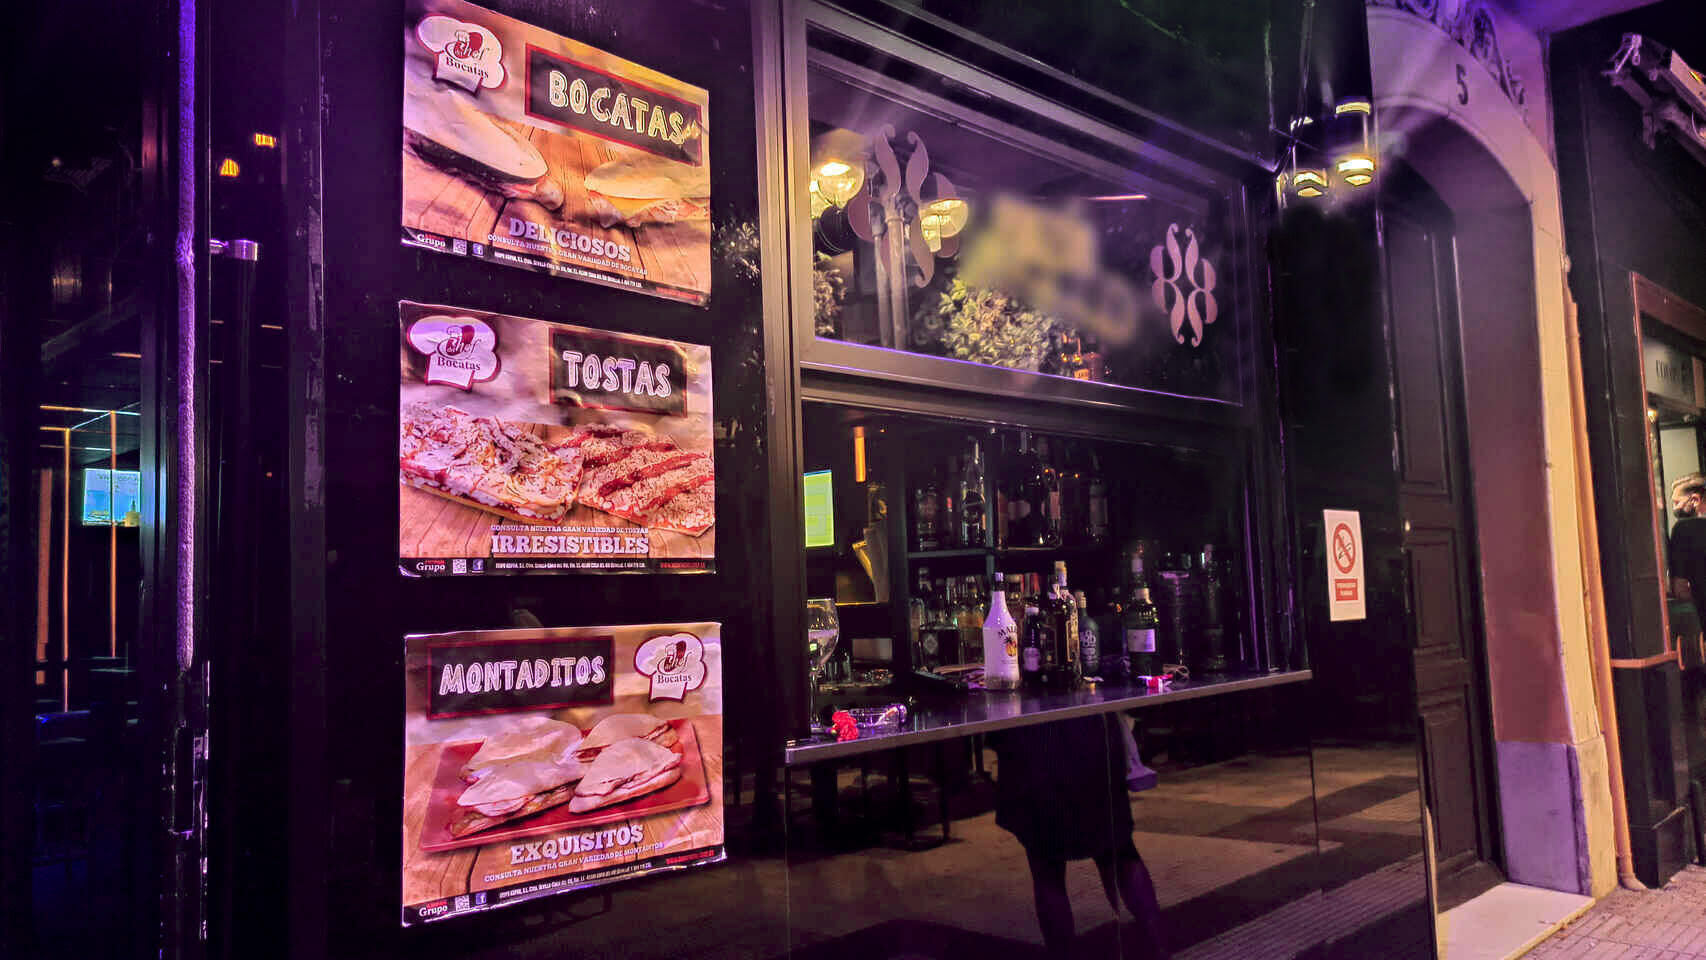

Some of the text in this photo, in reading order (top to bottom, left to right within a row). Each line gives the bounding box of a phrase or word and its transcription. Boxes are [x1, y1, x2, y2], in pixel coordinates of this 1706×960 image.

[446, 57, 488, 78] Bocatas
[1456, 64, 1468, 105] 5
[549, 70, 685, 145] BOCATAS
[417, 233, 446, 247] Grupo
[488, 234, 526, 247] CONSULTA
[510, 217, 631, 262] DELICIOSOS
[437, 356, 480, 370] Bocatas
[562, 350, 672, 398] TOSTAS
[490, 524, 529, 532] CONSULTA
[490, 535, 649, 553] IRRESISTIBLES
[416, 562, 446, 573] Grupo
[439, 656, 607, 695] MONTADITOS
[657, 675, 692, 684] Bocatas
[510, 824, 644, 865] EXQUISITOS
[484, 869, 523, 882] CONSULTA
[558, 858, 578, 868] GRAN
[419, 904, 448, 917] Grupo
